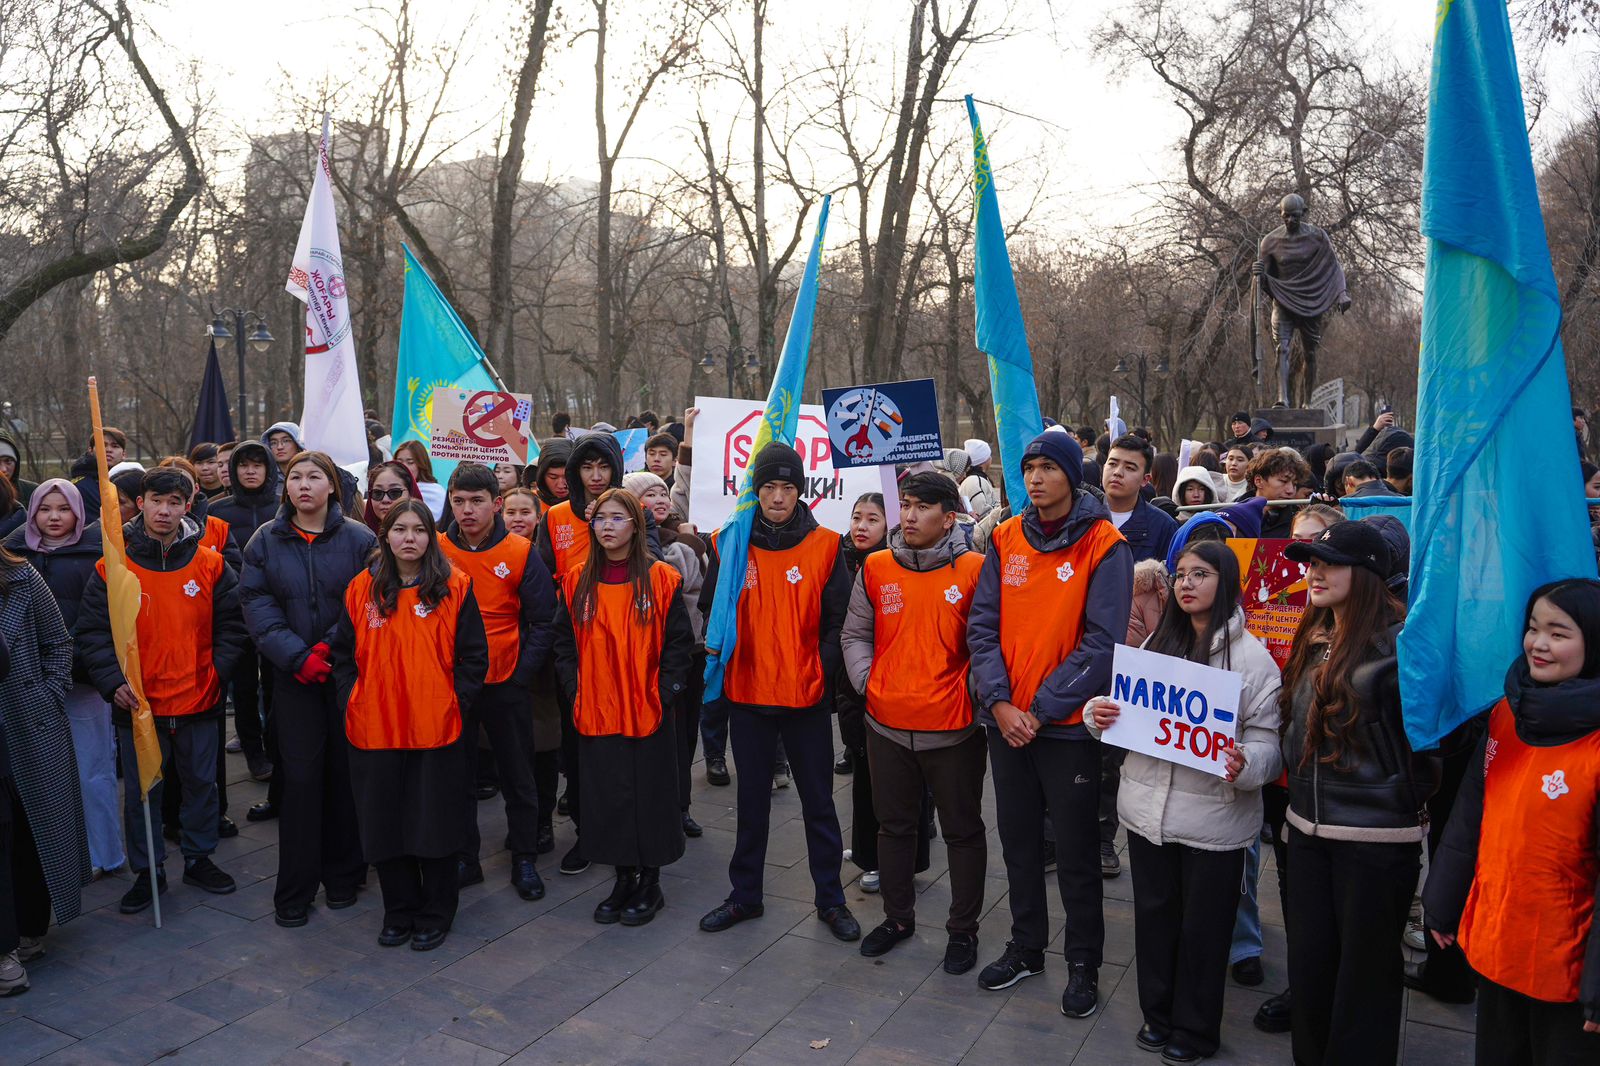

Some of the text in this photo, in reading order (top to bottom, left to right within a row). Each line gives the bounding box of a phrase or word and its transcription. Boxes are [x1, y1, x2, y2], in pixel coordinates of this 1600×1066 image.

[432, 444, 479, 452] КОМЬЮНИТИ
[906, 442, 940, 452] ЦЕНТРА
[461, 453, 510, 462] НАРКОТИКОВ
[885, 450, 941, 461] НАРКОТИКОВ
[1009, 554, 1030, 566] VOL
[880, 583, 902, 595] VOL
[1257, 623, 1297, 635] НАРКОТИКО
